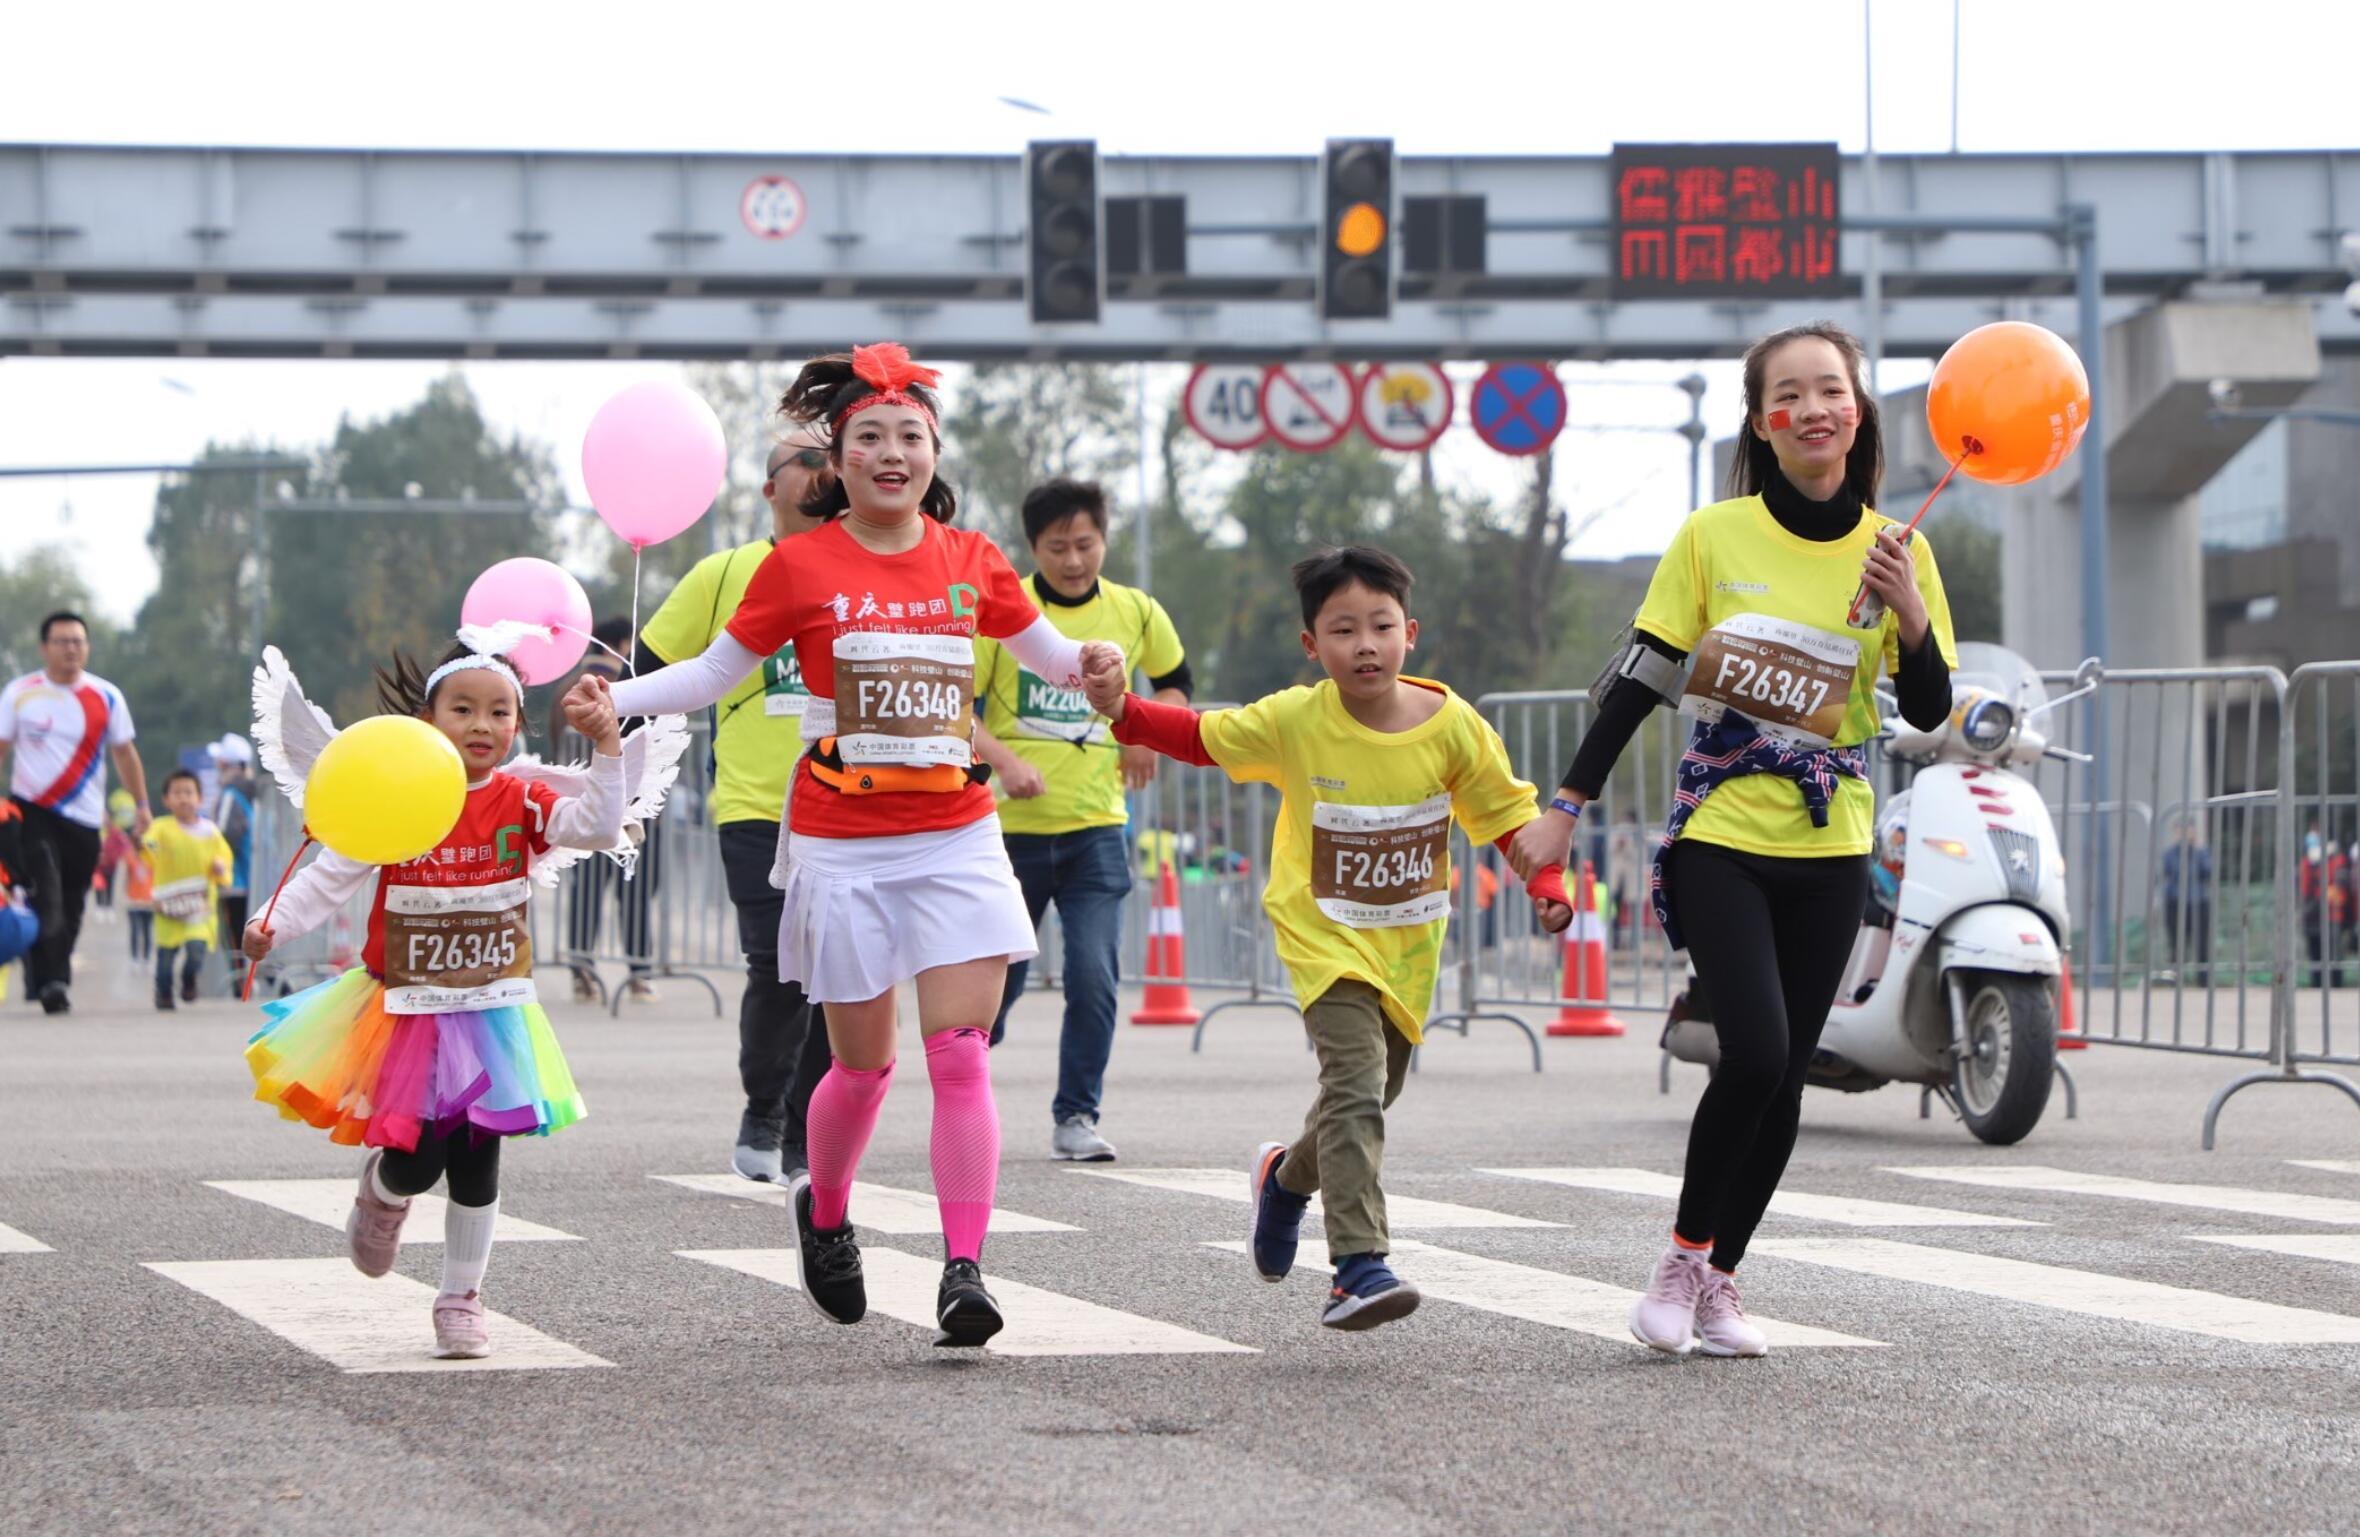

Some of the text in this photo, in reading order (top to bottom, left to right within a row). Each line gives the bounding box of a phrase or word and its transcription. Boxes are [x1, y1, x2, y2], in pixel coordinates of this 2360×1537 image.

[1207, 375, 1260, 424] 40
[838, 621, 863, 637] just
[868, 620, 891, 634] felt
[895, 622, 919, 635] like
[922, 618, 972, 635] running
[858, 680, 961, 721] F26348
[1714, 653, 1830, 717] F26347
[422, 869, 441, 881] felt
[446, 869, 466, 881] like
[1335, 842, 1434, 888] F26346
[408, 928, 516, 971] F26345
